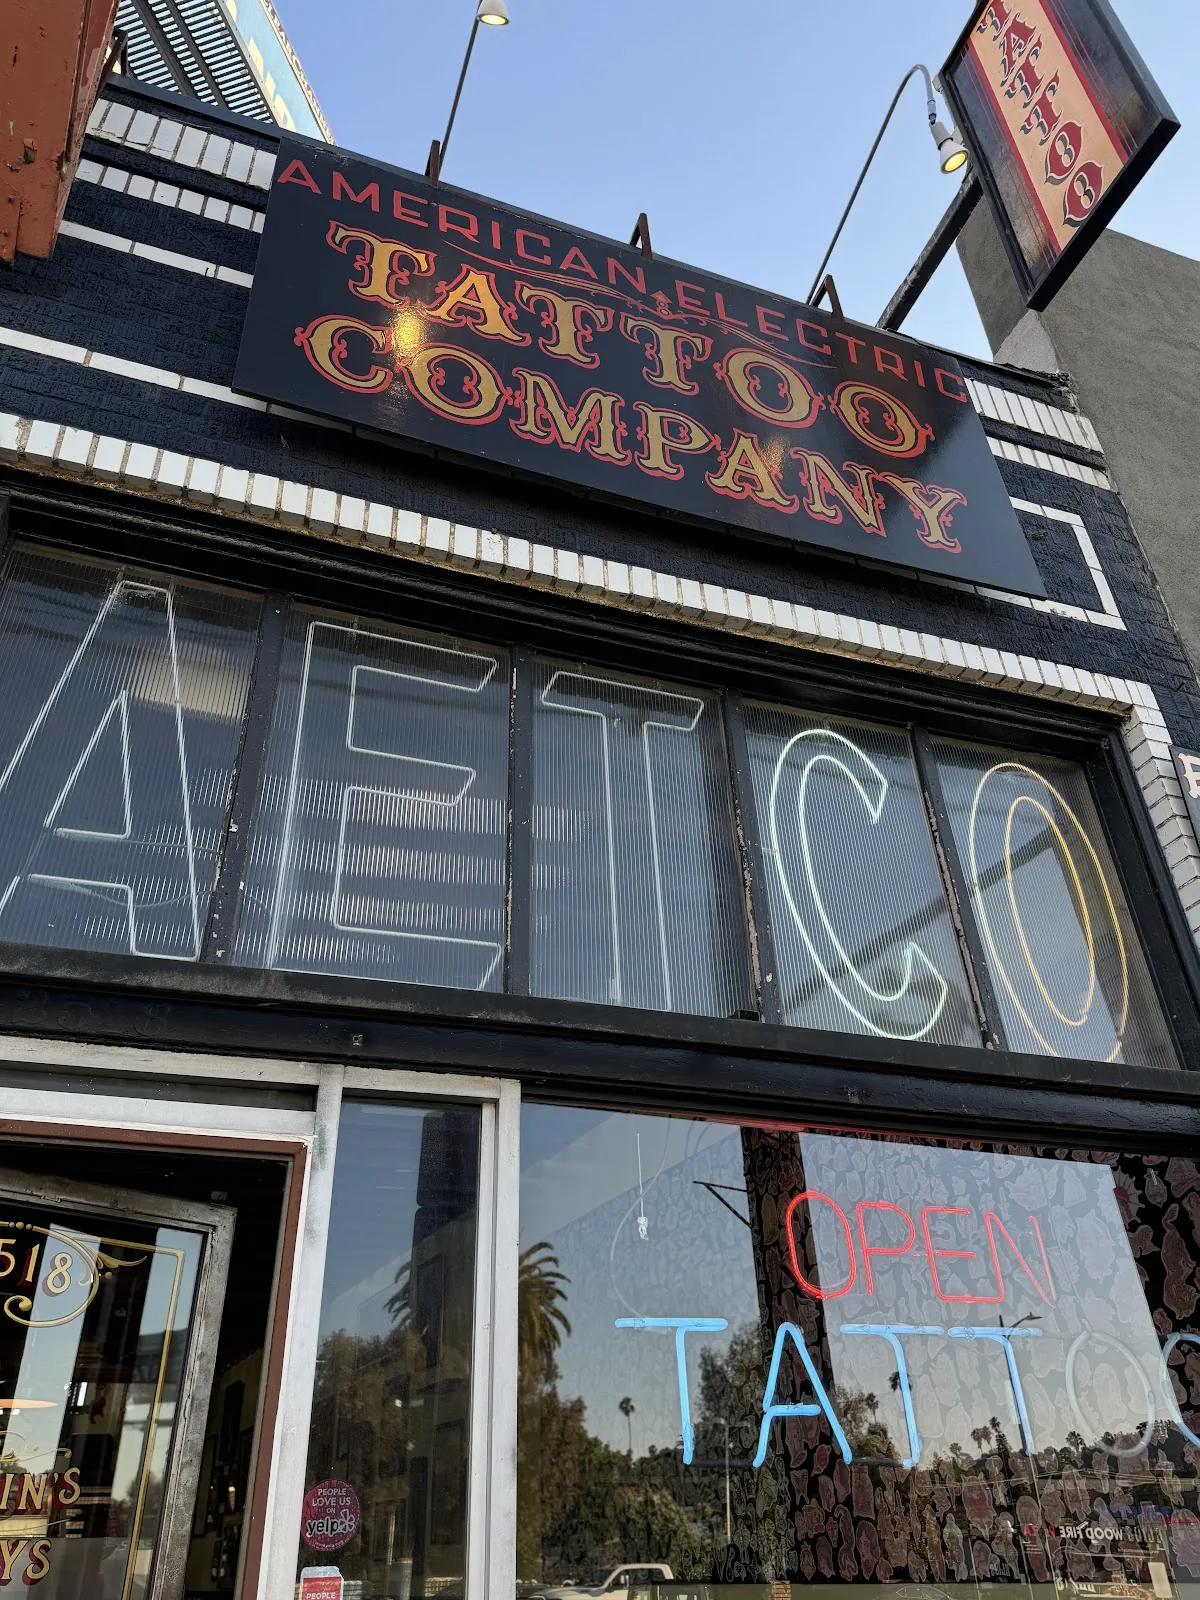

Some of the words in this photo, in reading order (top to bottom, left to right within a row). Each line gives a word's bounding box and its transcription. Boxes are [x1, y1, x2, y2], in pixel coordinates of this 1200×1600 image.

[277, 159, 647, 294] AMERICAN
[674, 279, 968, 403] ELECTRIC
[325, 220, 935, 459] TATTOO
[294, 314, 968, 555] COMPANY
[785, 1190, 1057, 1307] OPEN
[305, 1515, 340, 1537] yelp
[312, 1497, 337, 1507] LOVE
[339, 1496, 351, 1506] US
[317, 1488, 347, 1496] PEOPLE
[306, 1592, 336, 1600] PEOPLE
